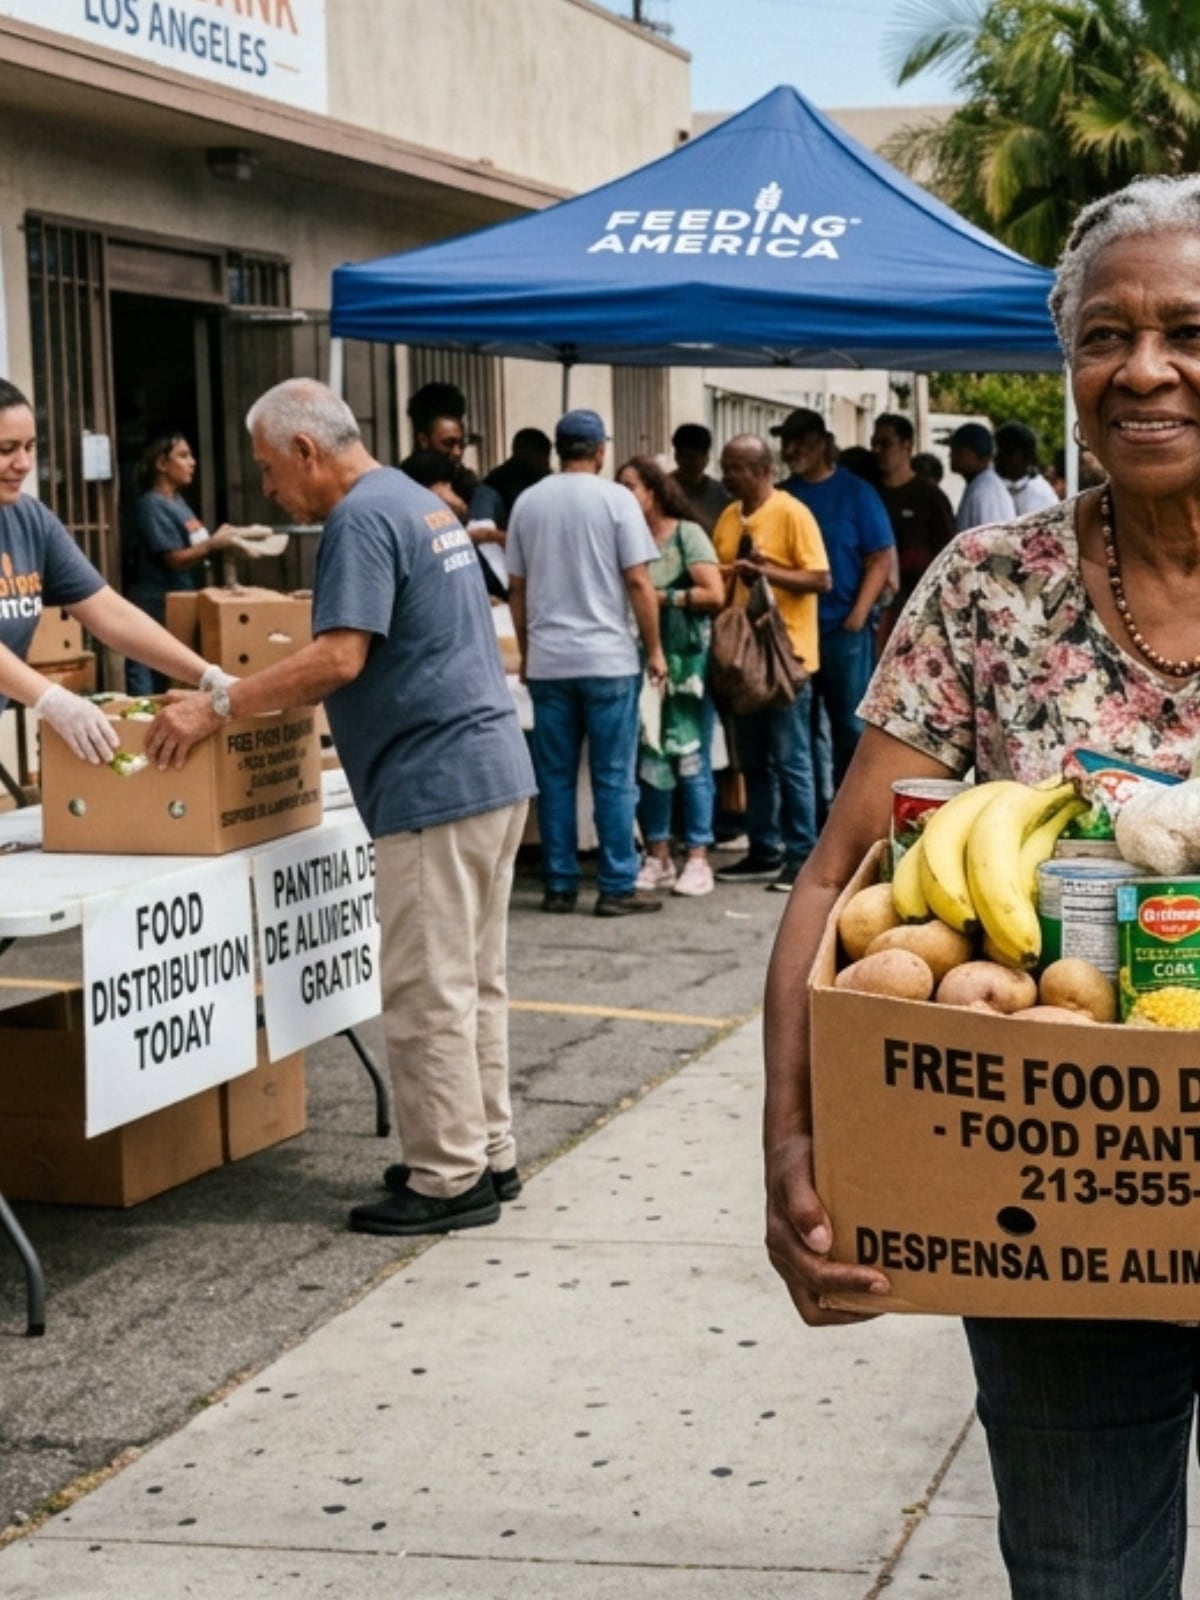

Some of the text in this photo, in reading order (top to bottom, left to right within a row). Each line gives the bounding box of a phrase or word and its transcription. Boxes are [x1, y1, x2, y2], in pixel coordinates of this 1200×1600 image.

[85, 0, 139, 36] LOS
[148, 2, 268, 77] ANGELES
[587, 233, 840, 260] AMERICA
[605, 205, 848, 238] FEEDING
[355, 843, 376, 881] DE
[136, 892, 204, 951] FOOD
[264, 920, 289, 966] DE
[92, 934, 250, 1026] DISTRIBUTION
[301, 945, 373, 1005] GRATIS
[134, 1003, 215, 1071] TODAY
[884, 1037, 1006, 1103] FREE
[1023, 1058, 1160, 1113] FOOD
[960, 1110, 1080, 1158] FOOD
[856, 1226, 1050, 1281] DESPENSA
[1061, 1246, 1110, 1284] DE
